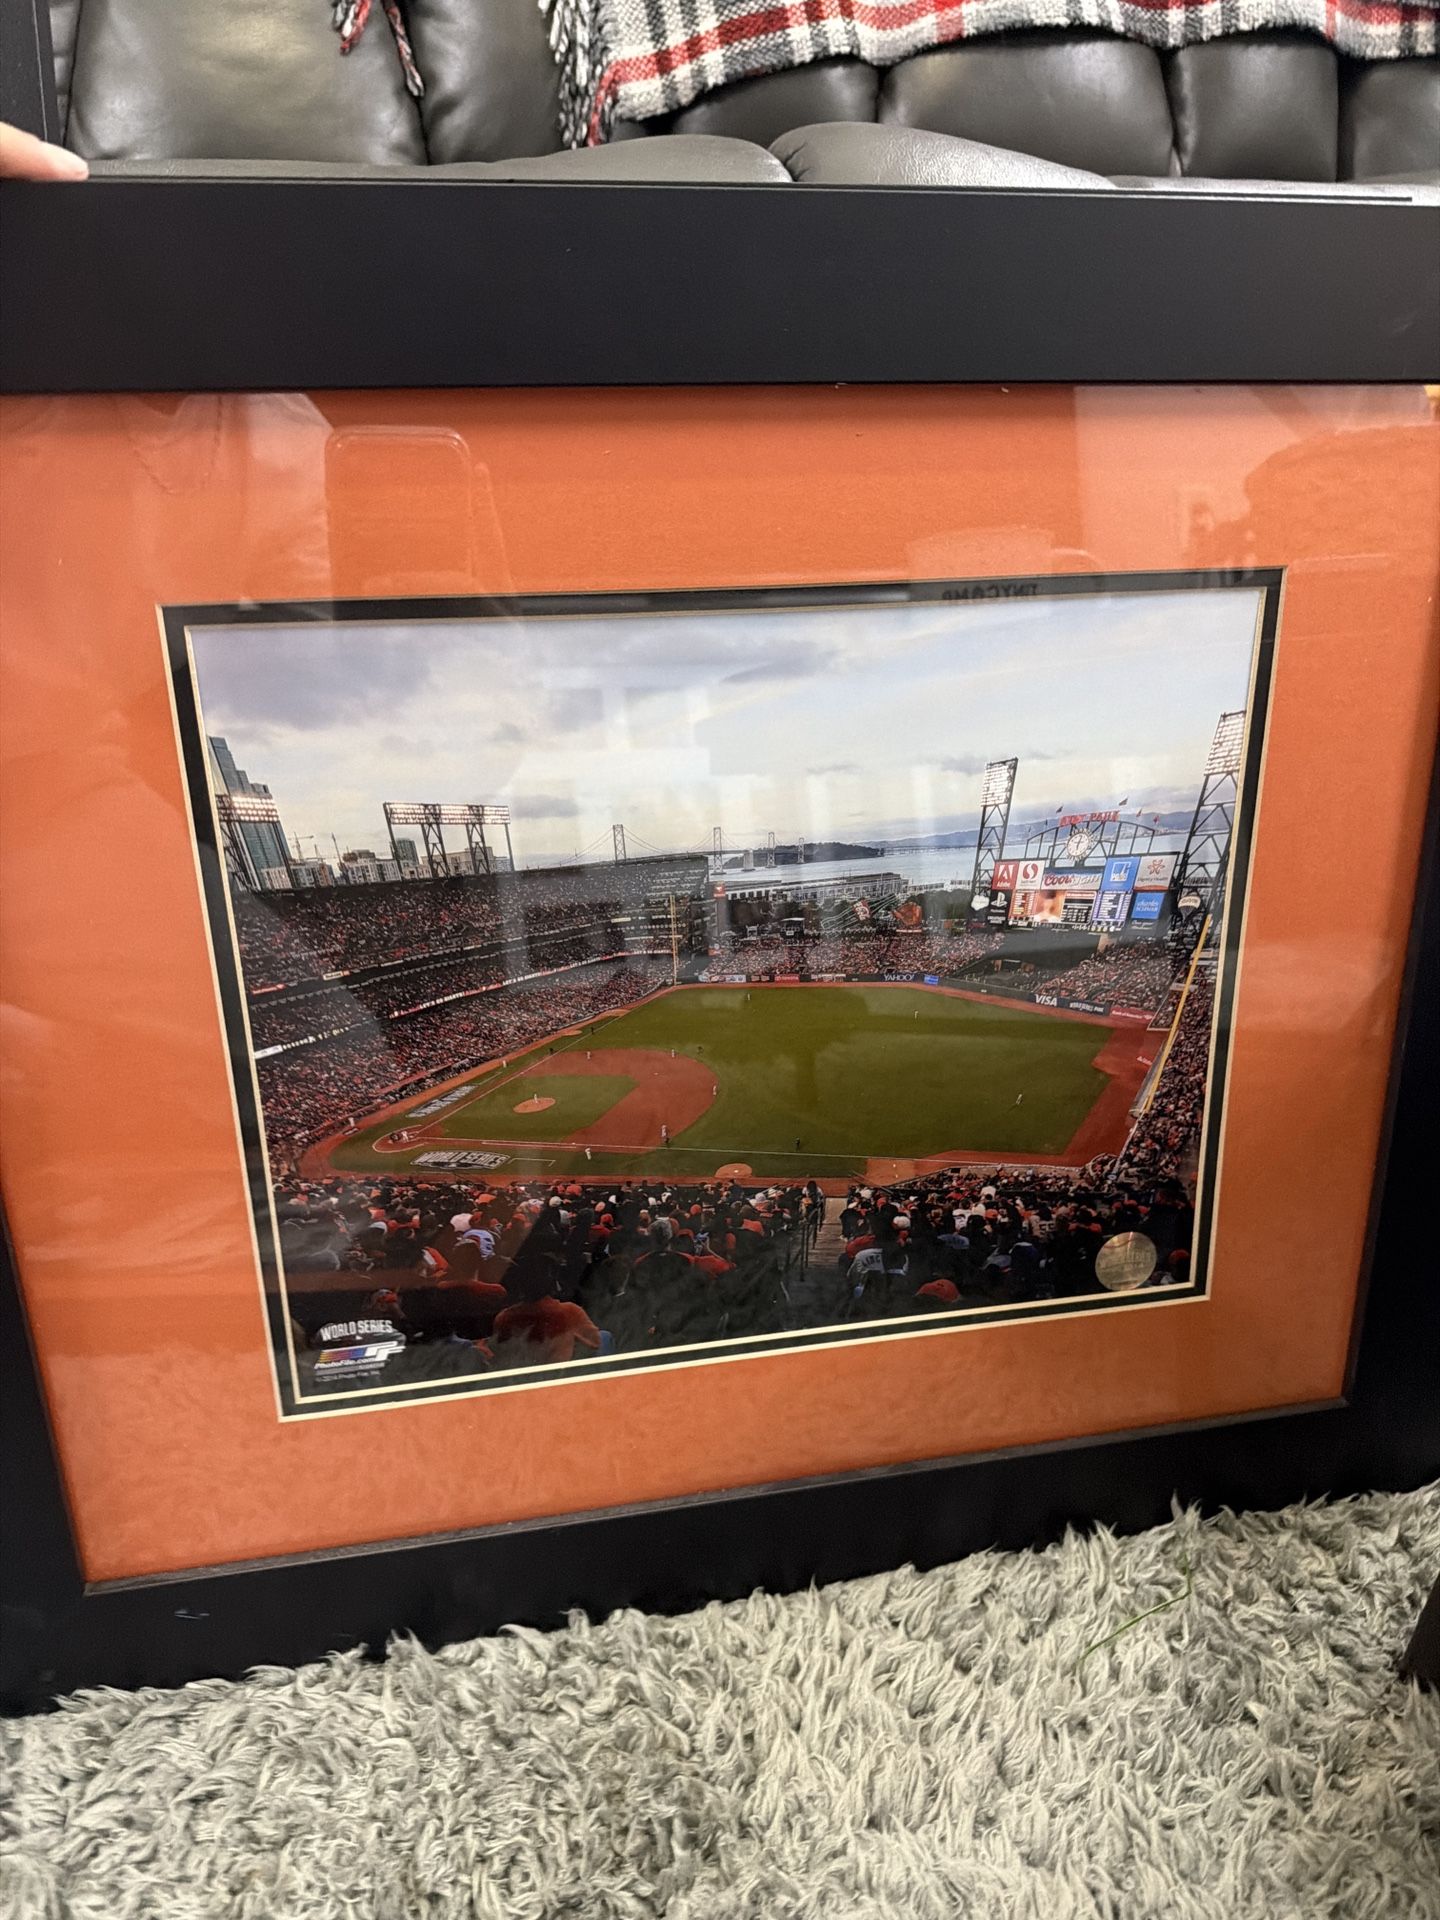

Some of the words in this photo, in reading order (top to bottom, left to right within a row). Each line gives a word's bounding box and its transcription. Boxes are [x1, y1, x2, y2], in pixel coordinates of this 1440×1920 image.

[1035, 994, 1058, 1007] VISA
[413, 1151, 461, 1163] WORLD
[460, 1152, 506, 1168] SERIES
[320, 1321, 357, 1341] WORLD
[357, 1319, 394, 1334] SERIES
